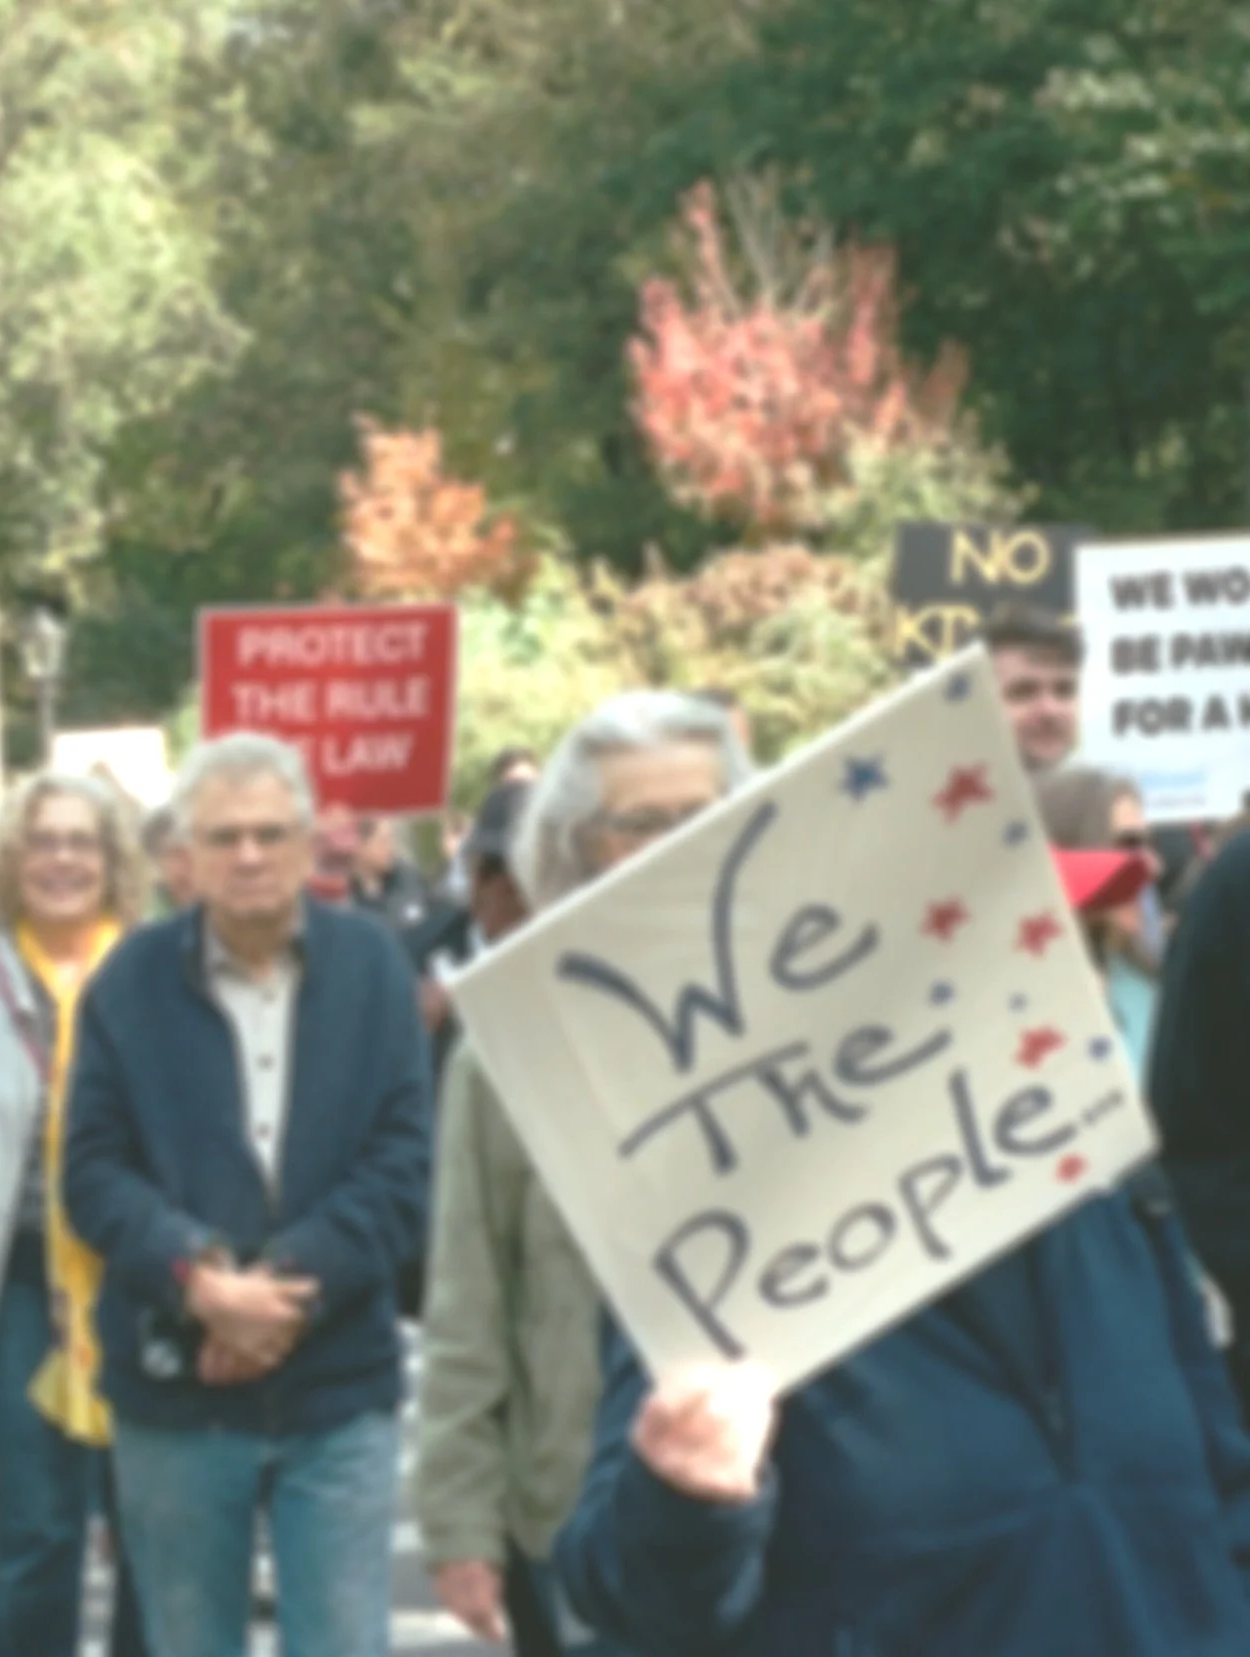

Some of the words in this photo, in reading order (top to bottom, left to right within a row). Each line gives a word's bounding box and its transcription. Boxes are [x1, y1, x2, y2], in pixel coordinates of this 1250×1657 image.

[951, 530, 1049, 584] NO
[1109, 570, 1173, 611] WE
[238, 621, 428, 666] PROTECT
[1111, 633, 1160, 674] BE
[232, 681, 317, 722] THE
[326, 676, 431, 720] RULE
[1112, 695, 1193, 737] FOR
[1201, 692, 1231, 731] A
[323, 732, 415, 775] LAW
[556, 799, 882, 1075] We
[617, 1025, 955, 1177] The
